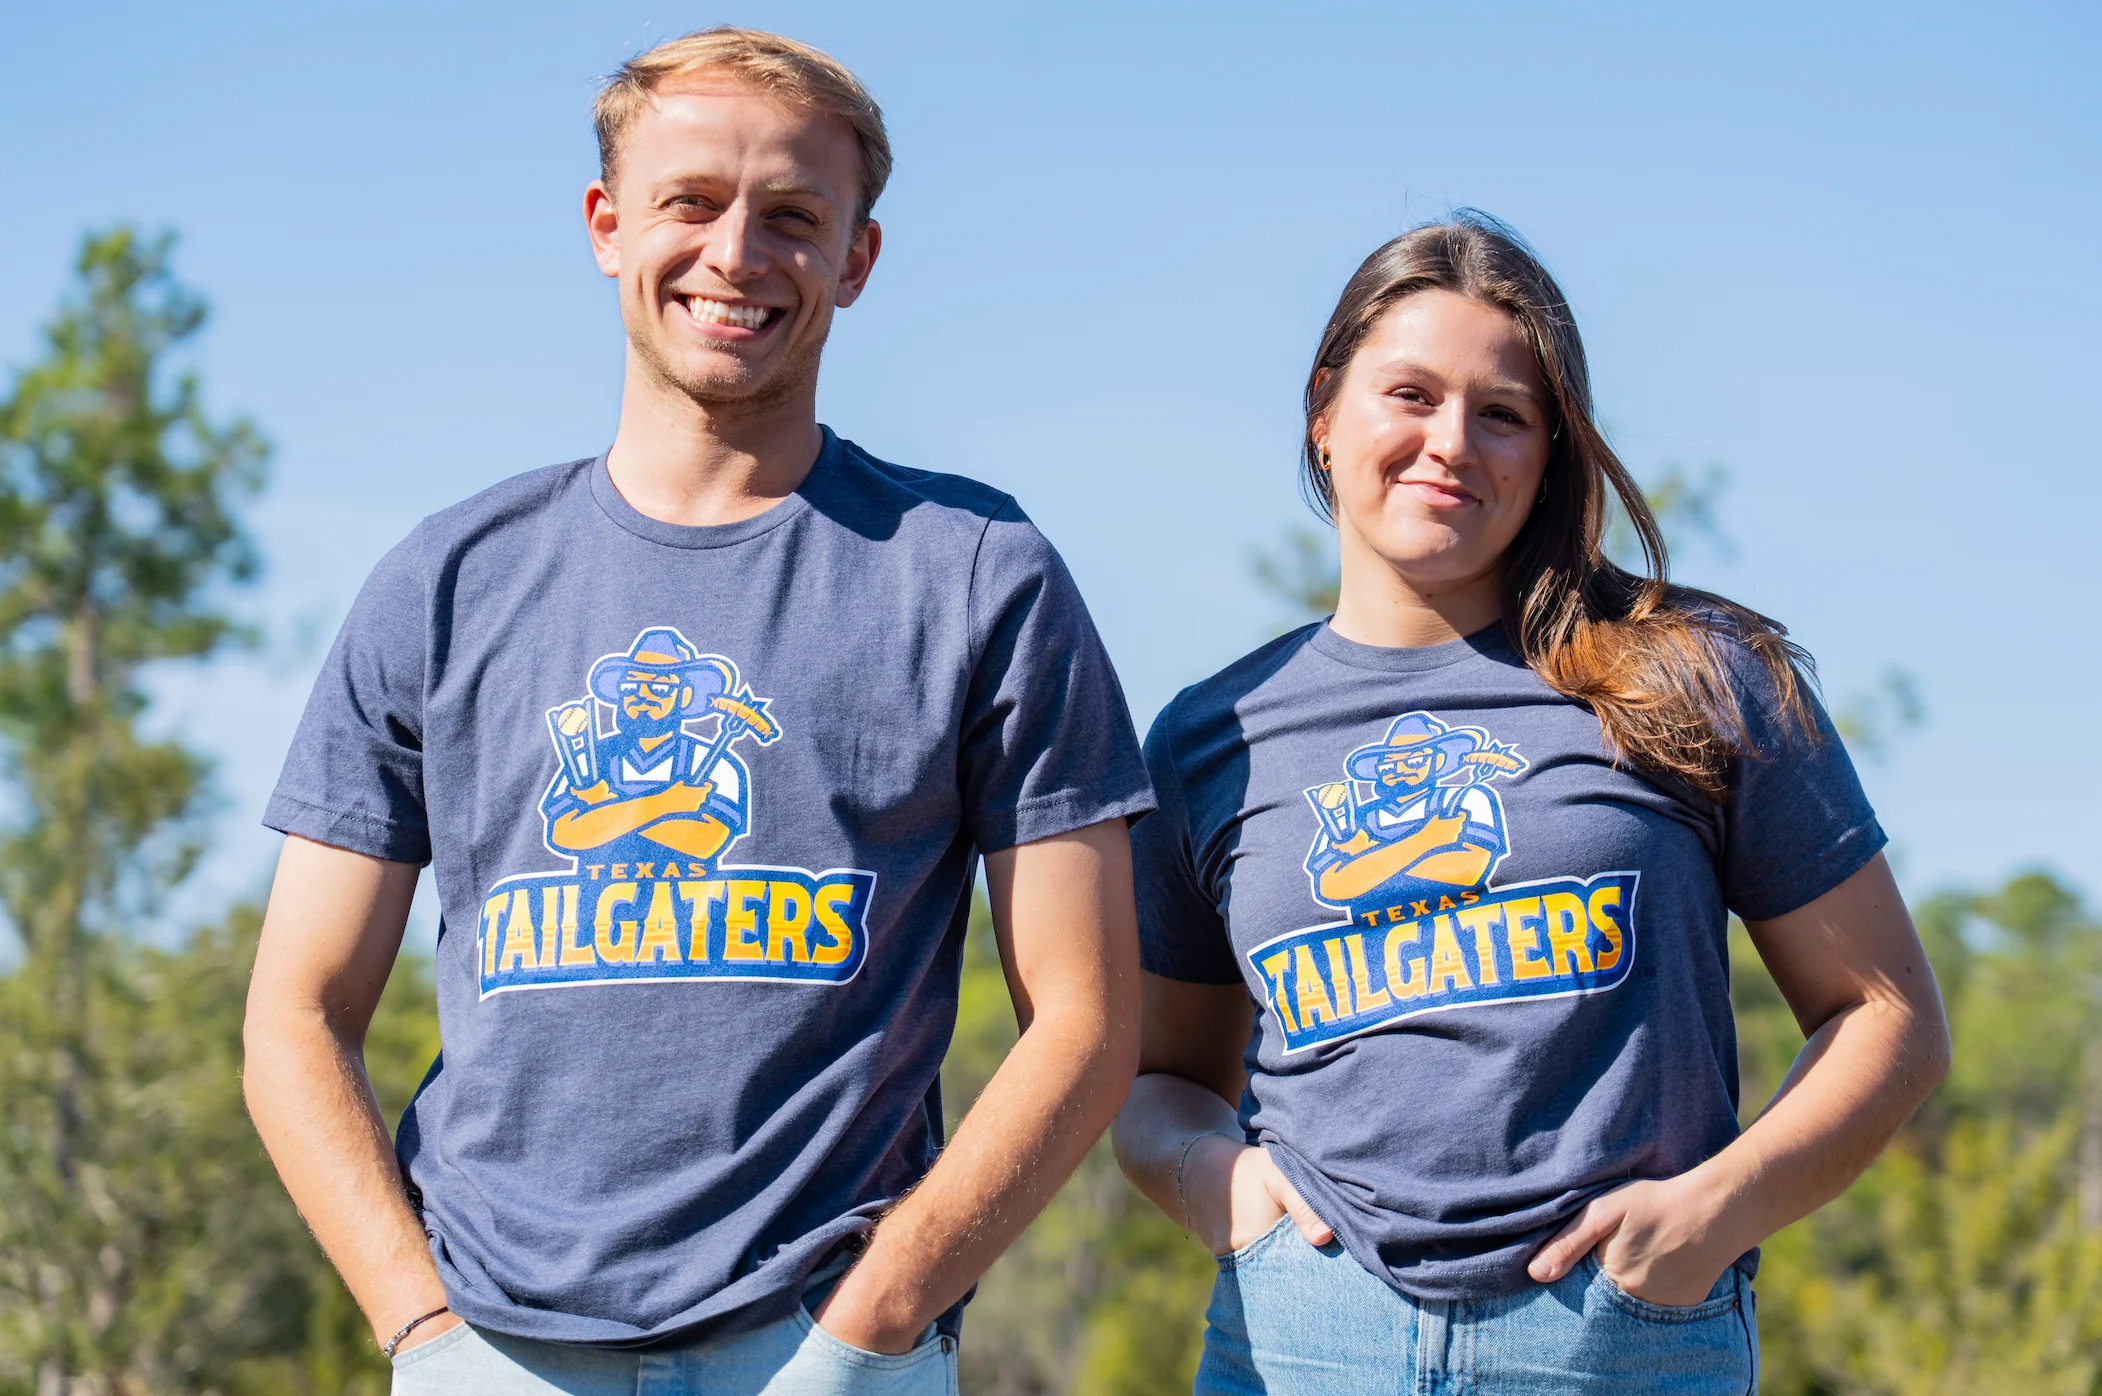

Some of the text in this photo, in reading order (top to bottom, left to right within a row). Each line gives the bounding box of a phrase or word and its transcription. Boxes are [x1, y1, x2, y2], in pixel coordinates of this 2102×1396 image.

[586, 862, 707, 880] TEXAS
[483, 880, 855, 976] TAILGATERS
[1360, 890, 1481, 927] TEXAS
[1261, 886, 1623, 1034] TAILGATERS
